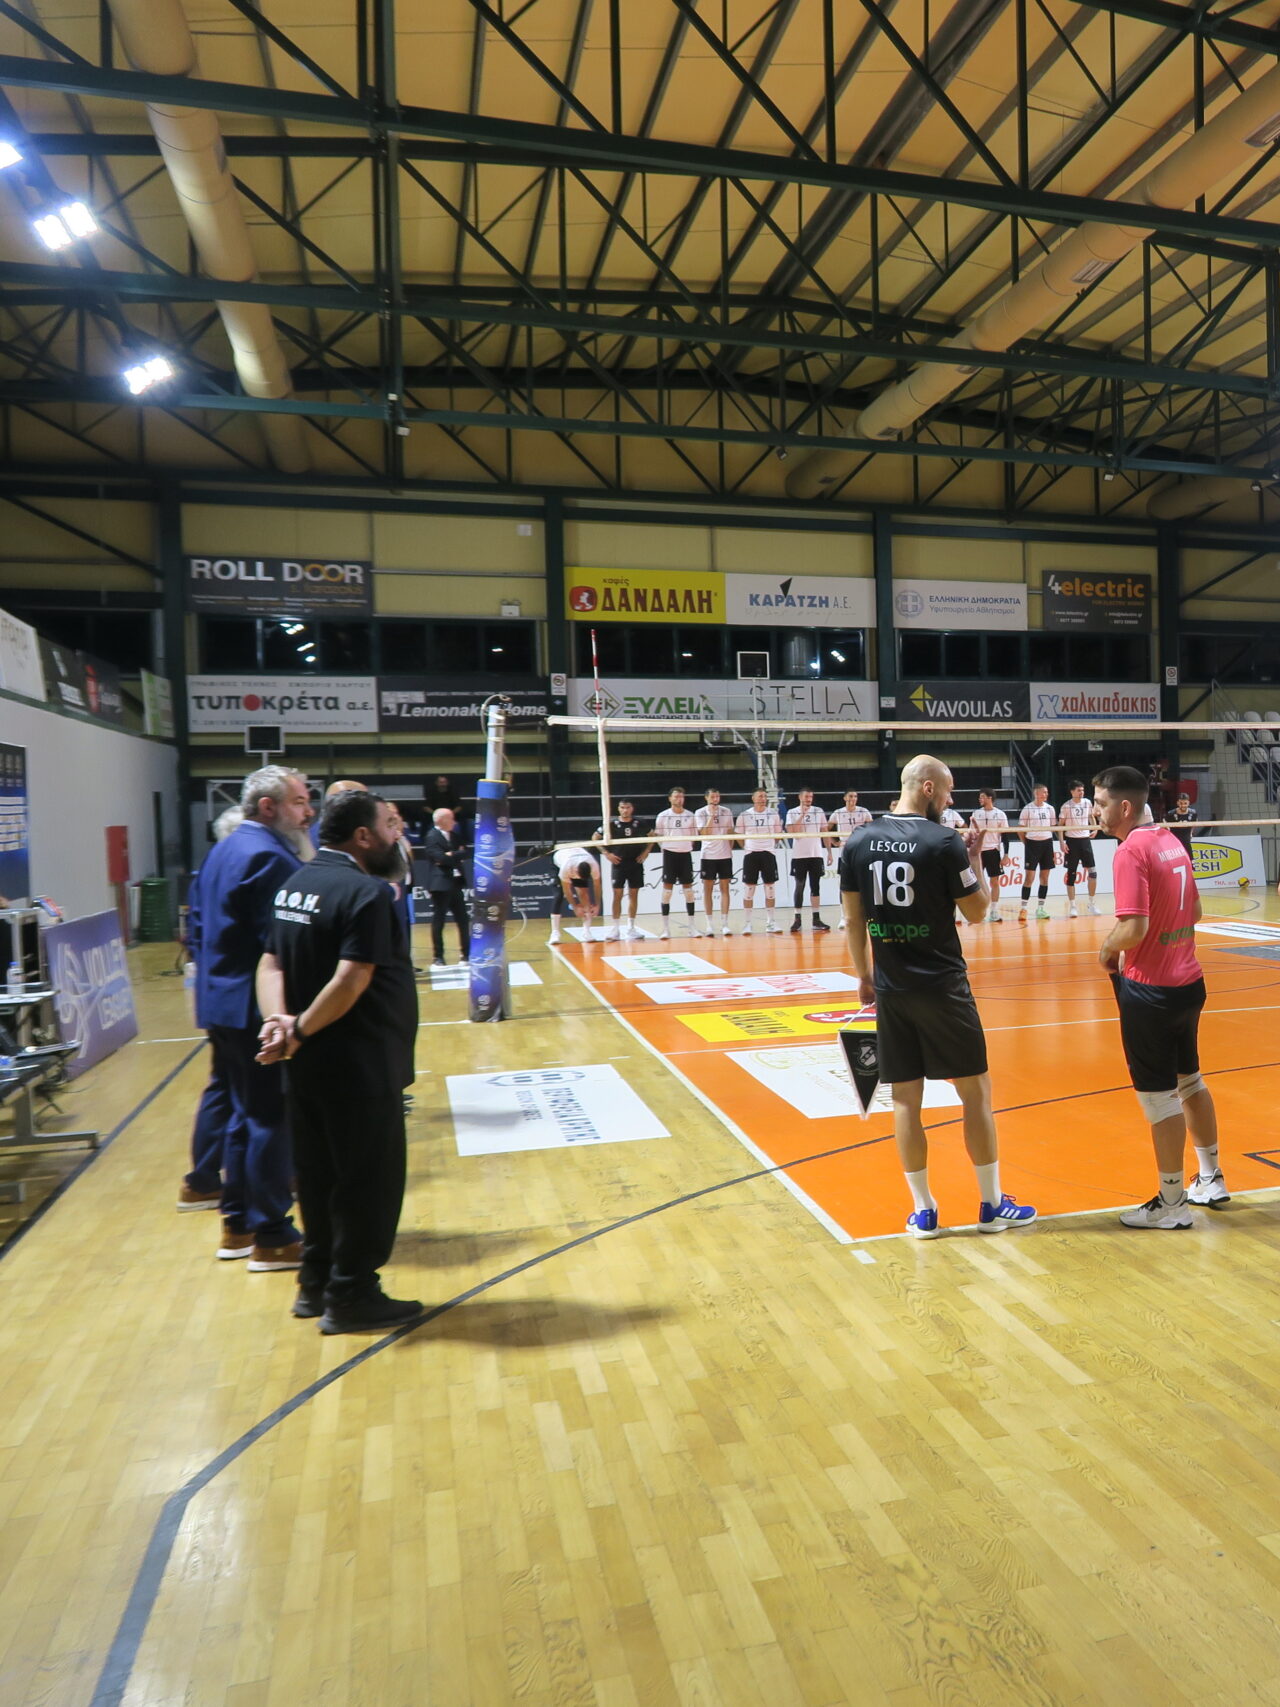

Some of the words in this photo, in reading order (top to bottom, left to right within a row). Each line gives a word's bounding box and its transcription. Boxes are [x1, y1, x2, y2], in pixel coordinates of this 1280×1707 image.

[190, 559, 275, 581] ROLL
[282, 562, 364, 584] DOOR
[1047, 574, 1145, 599] 4electric
[601, 587, 712, 613] ΔΑΝΔΑΛΗ
[749, 594, 829, 608] ΚΑΡΑΤΖΗ
[929, 595, 969, 603] ΕΛΛΗΝΙΚΗ
[971, 597, 1021, 605] ΔΗΜΟΚΡΑΤΙΑ
[623, 697, 715, 714] ΞΥΛΕΙΑ
[749, 686, 860, 714] STELLA
[925, 700, 1013, 718] VAVOULAS
[625, 828, 631, 836] 9
[755, 819, 765, 827] 17
[870, 840, 917, 853] LESCOV
[1192, 849, 1229, 860] CKEN
[1193, 861, 1221, 872] ESH
[869, 861, 915, 907] 18
[992, 869, 1023, 888] ola
[1172, 865, 1187, 910] 7
[868, 922, 930, 940] europe
